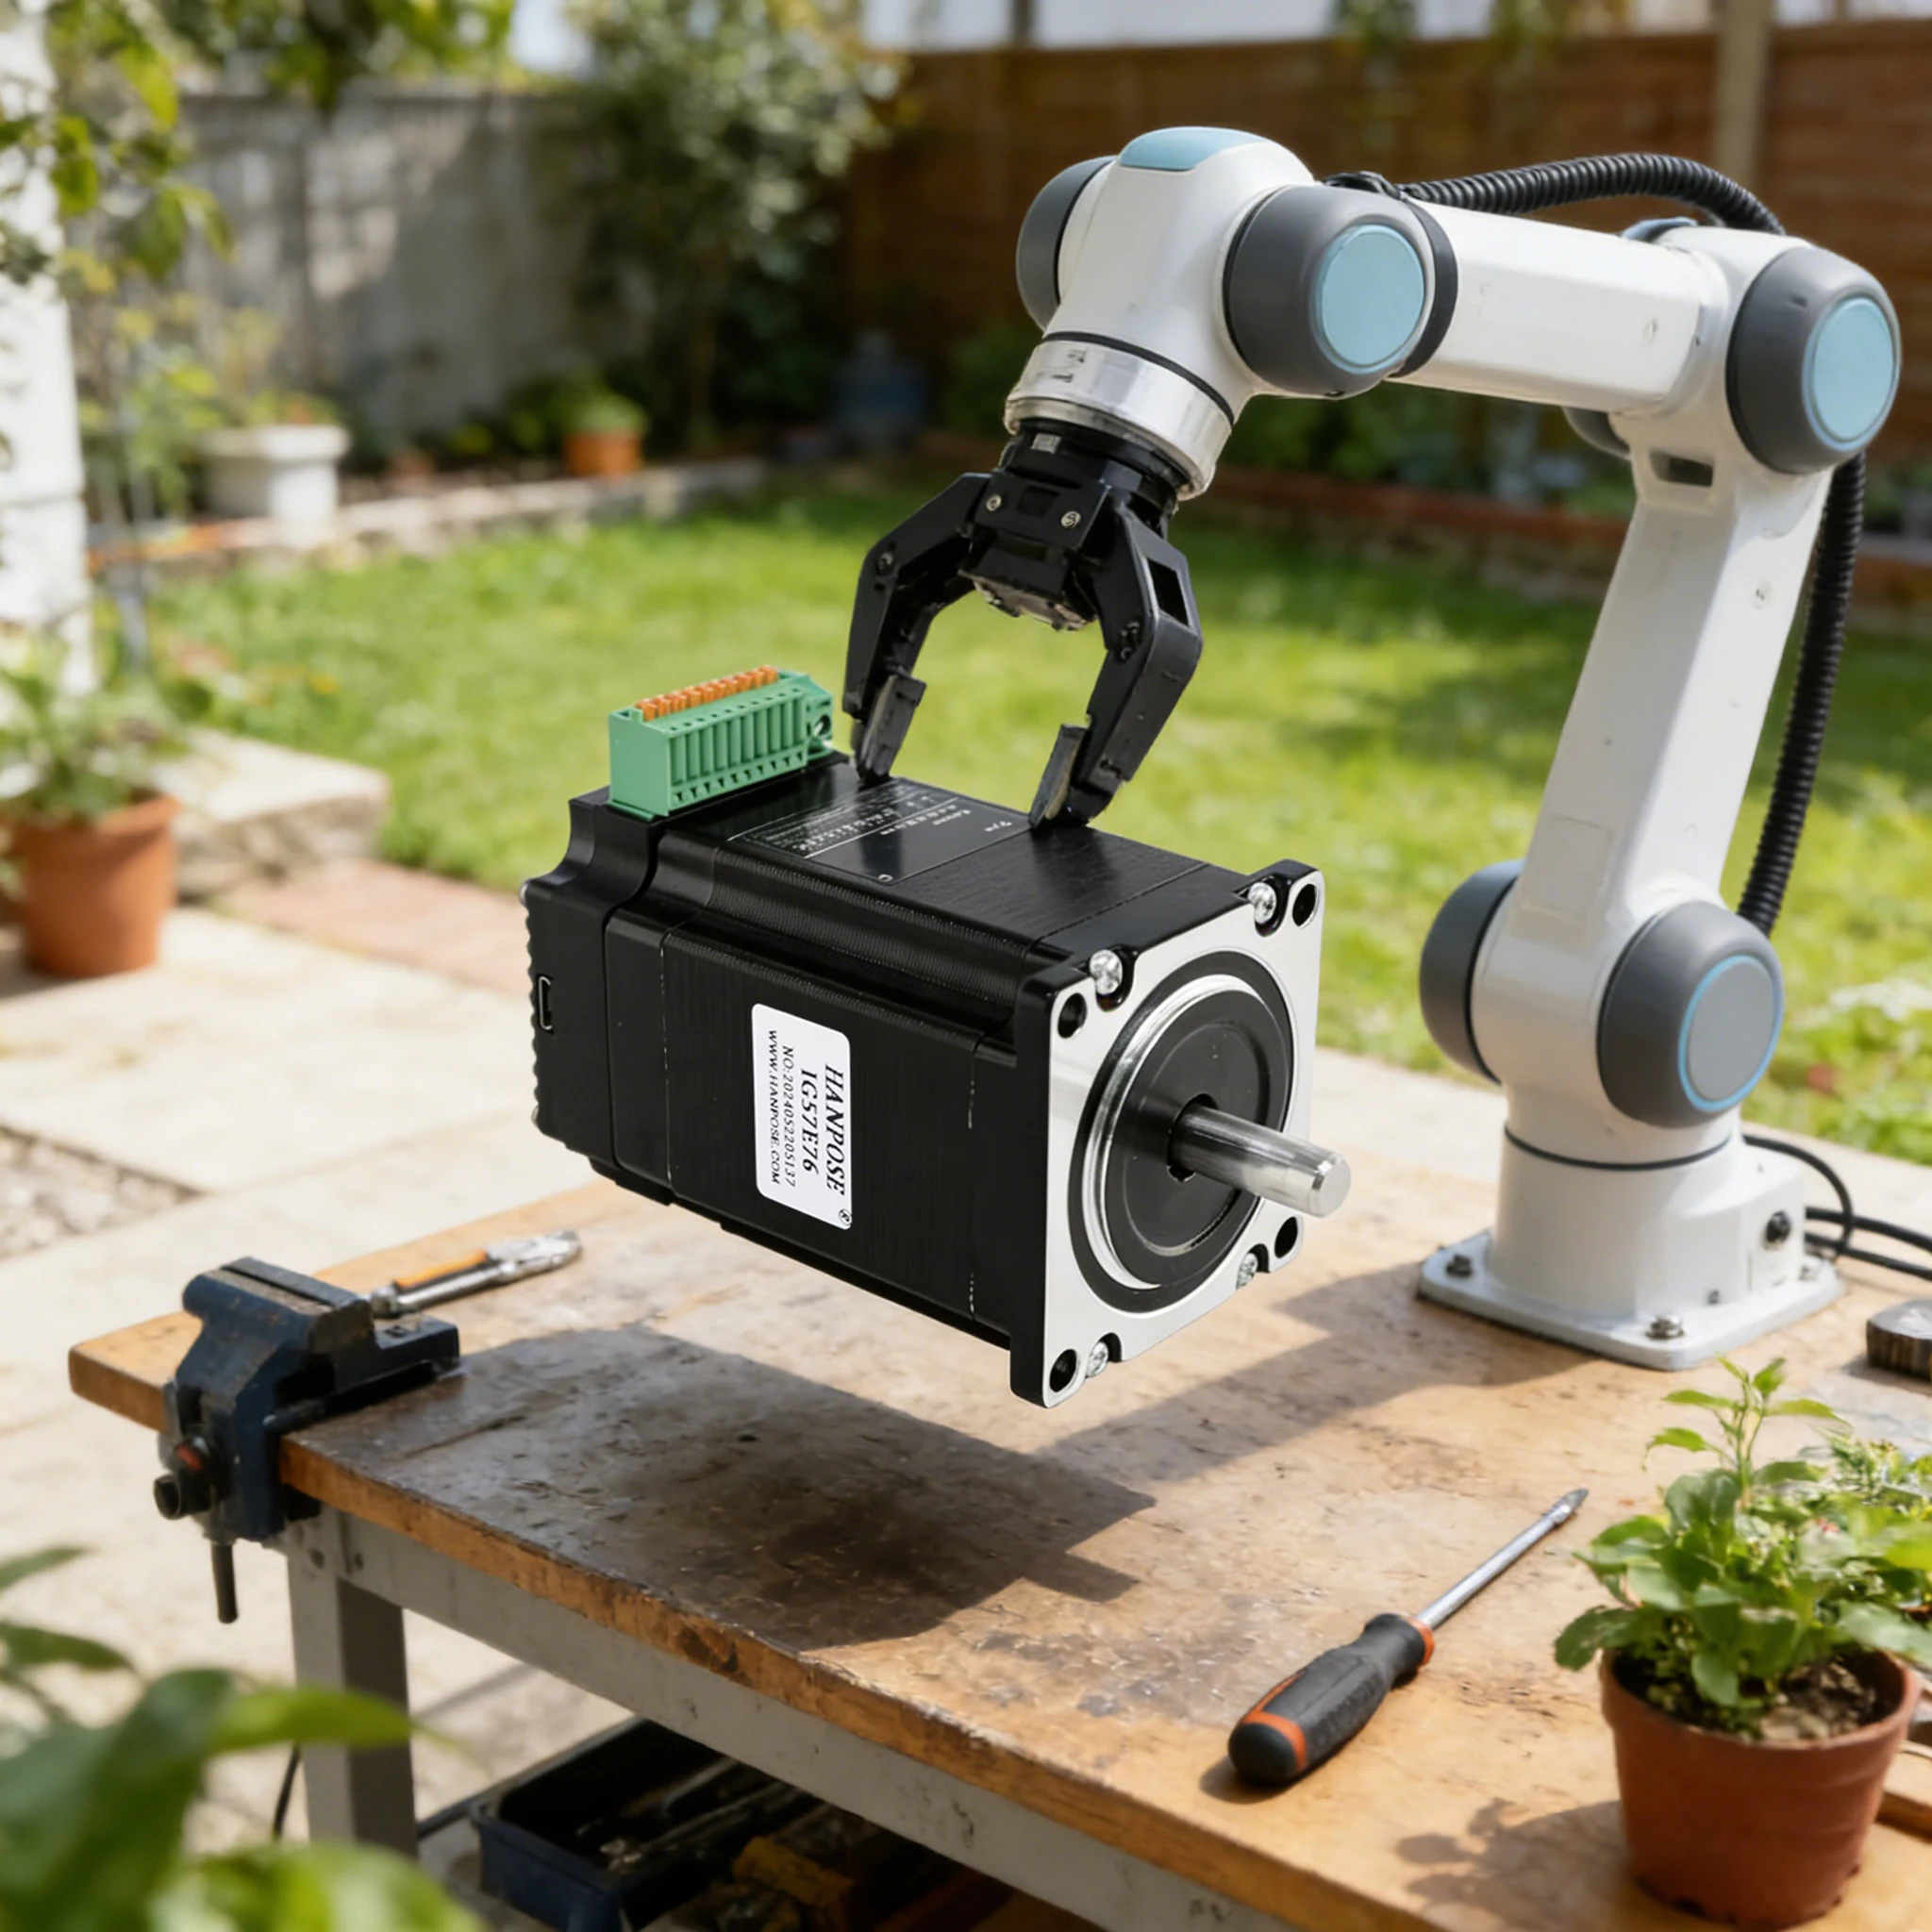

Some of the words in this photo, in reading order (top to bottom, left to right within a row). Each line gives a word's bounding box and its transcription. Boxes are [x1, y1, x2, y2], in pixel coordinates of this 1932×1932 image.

[769, 1030, 780, 1185] WWW.HANPOSE.COM
[801, 1068, 819, 1174] IG57E76
[824, 1064, 845, 1195] HANPOSE
